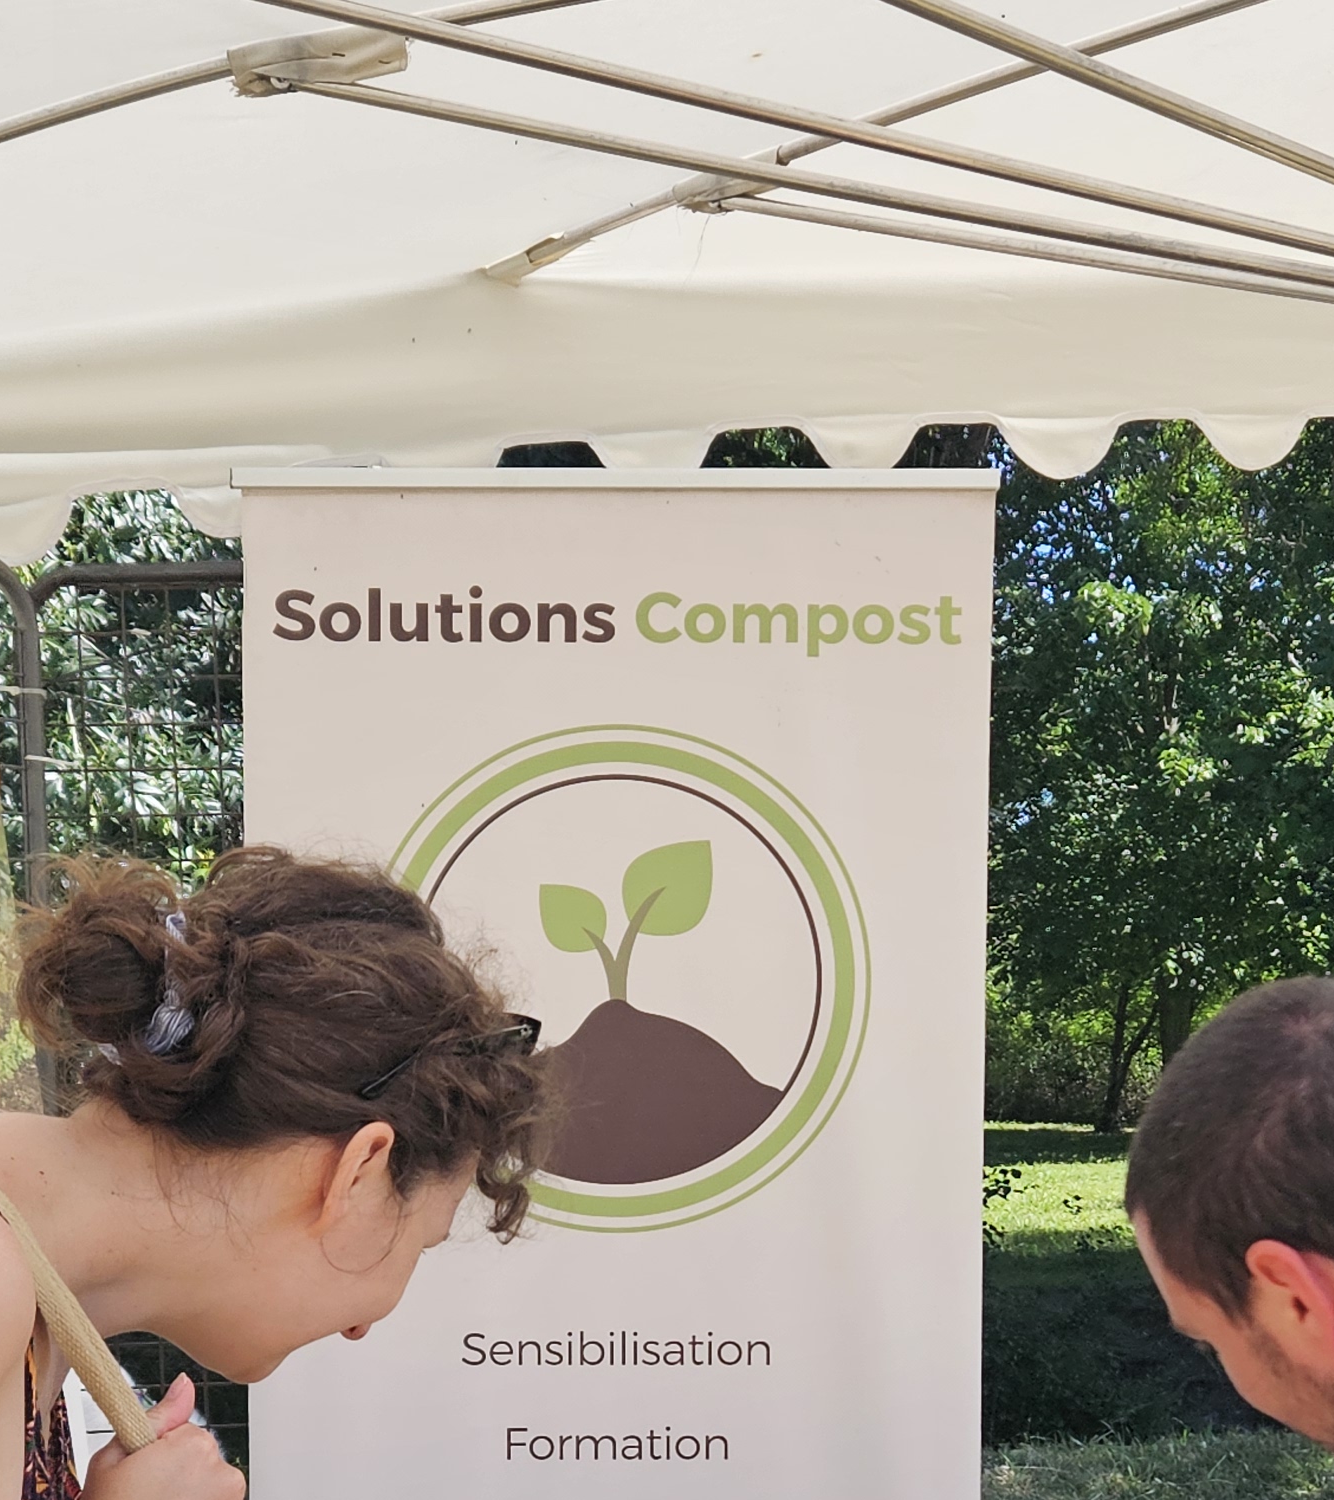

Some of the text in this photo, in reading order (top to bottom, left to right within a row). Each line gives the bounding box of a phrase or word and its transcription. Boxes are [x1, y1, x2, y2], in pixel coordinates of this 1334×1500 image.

[273, 585, 963, 658] Solutions Compost
[461, 1331, 772, 1366] Sensibilisation
[505, 1426, 729, 1461] Formation
